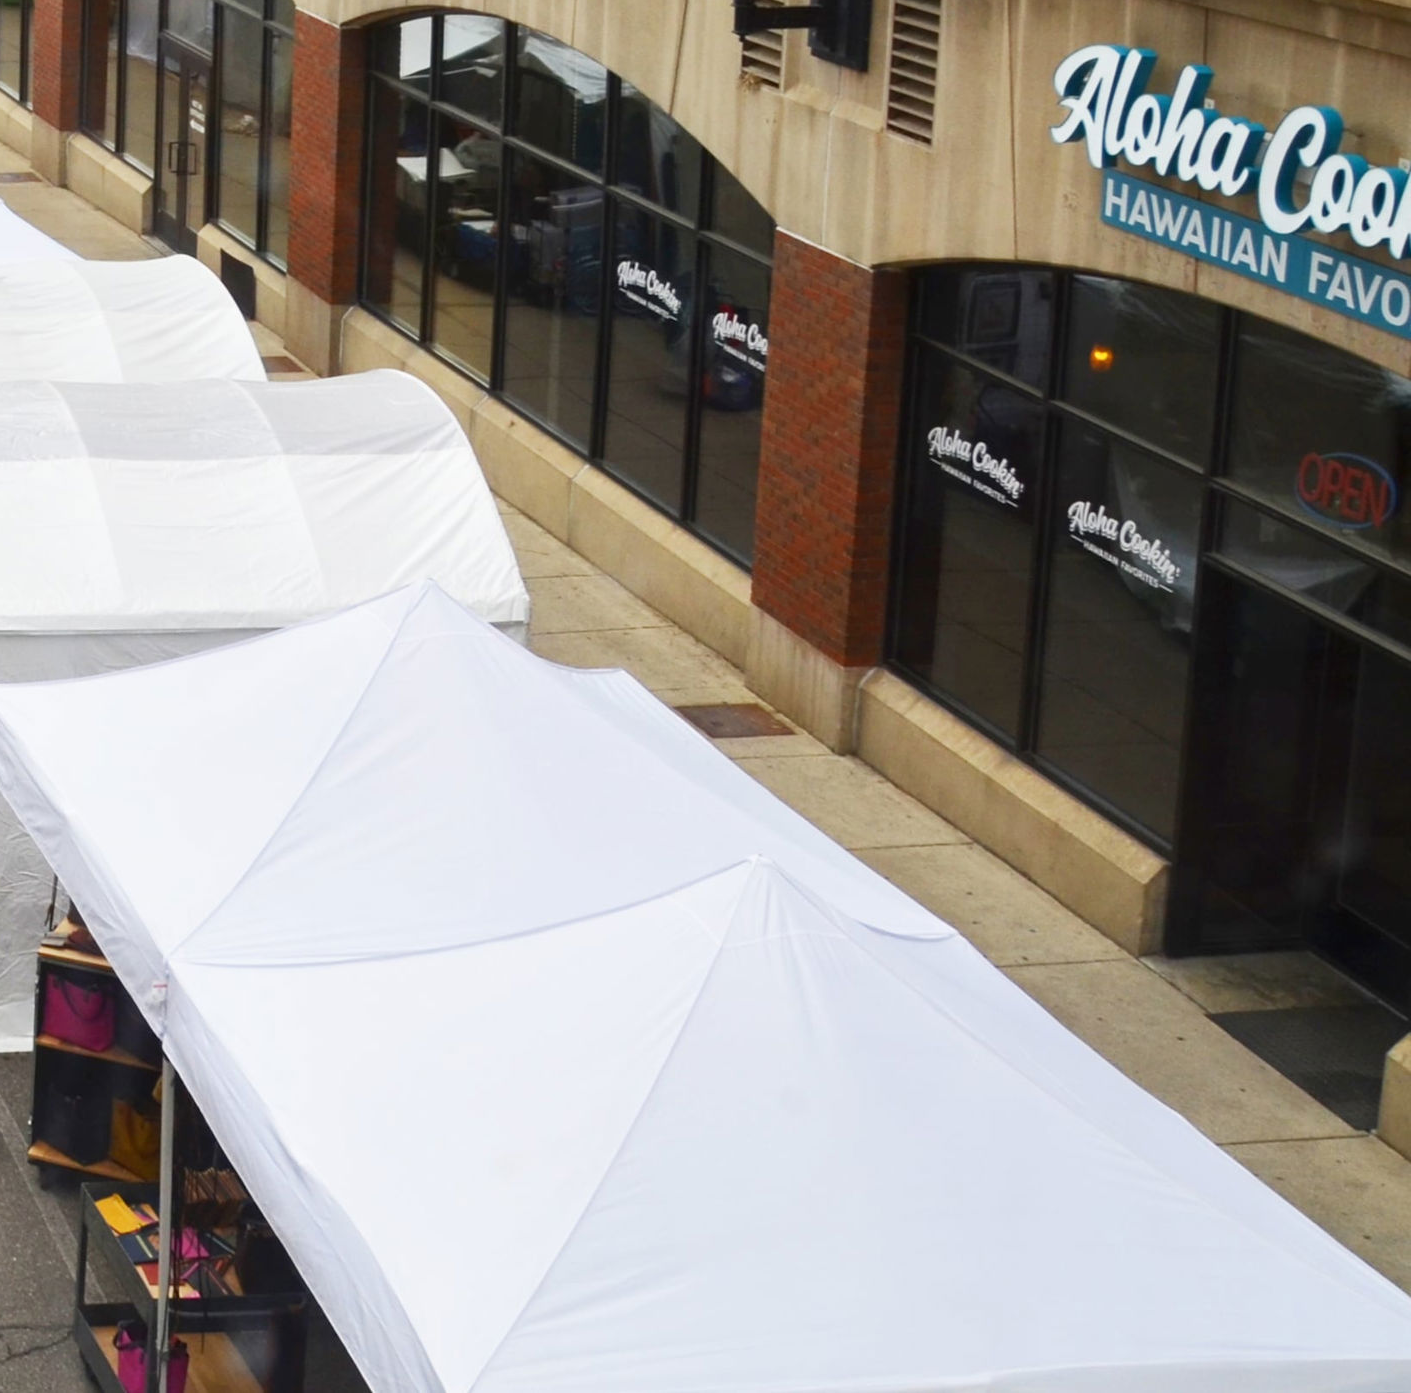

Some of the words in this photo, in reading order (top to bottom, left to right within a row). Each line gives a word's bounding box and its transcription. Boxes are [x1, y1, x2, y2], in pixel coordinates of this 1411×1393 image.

[1051, 44, 1261, 196] Aloha
[617, 261, 646, 288] Aloha
[1103, 177, 1290, 284] HAWAIIAN
[1308, 250, 1411, 328] FAVO
[712, 312, 746, 343] Aloha
[747, 324, 769, 356] Coo
[927, 427, 971, 461] Aloha
[1298, 452, 1388, 528] OPEN
[1068, 501, 1118, 541] Aloha
